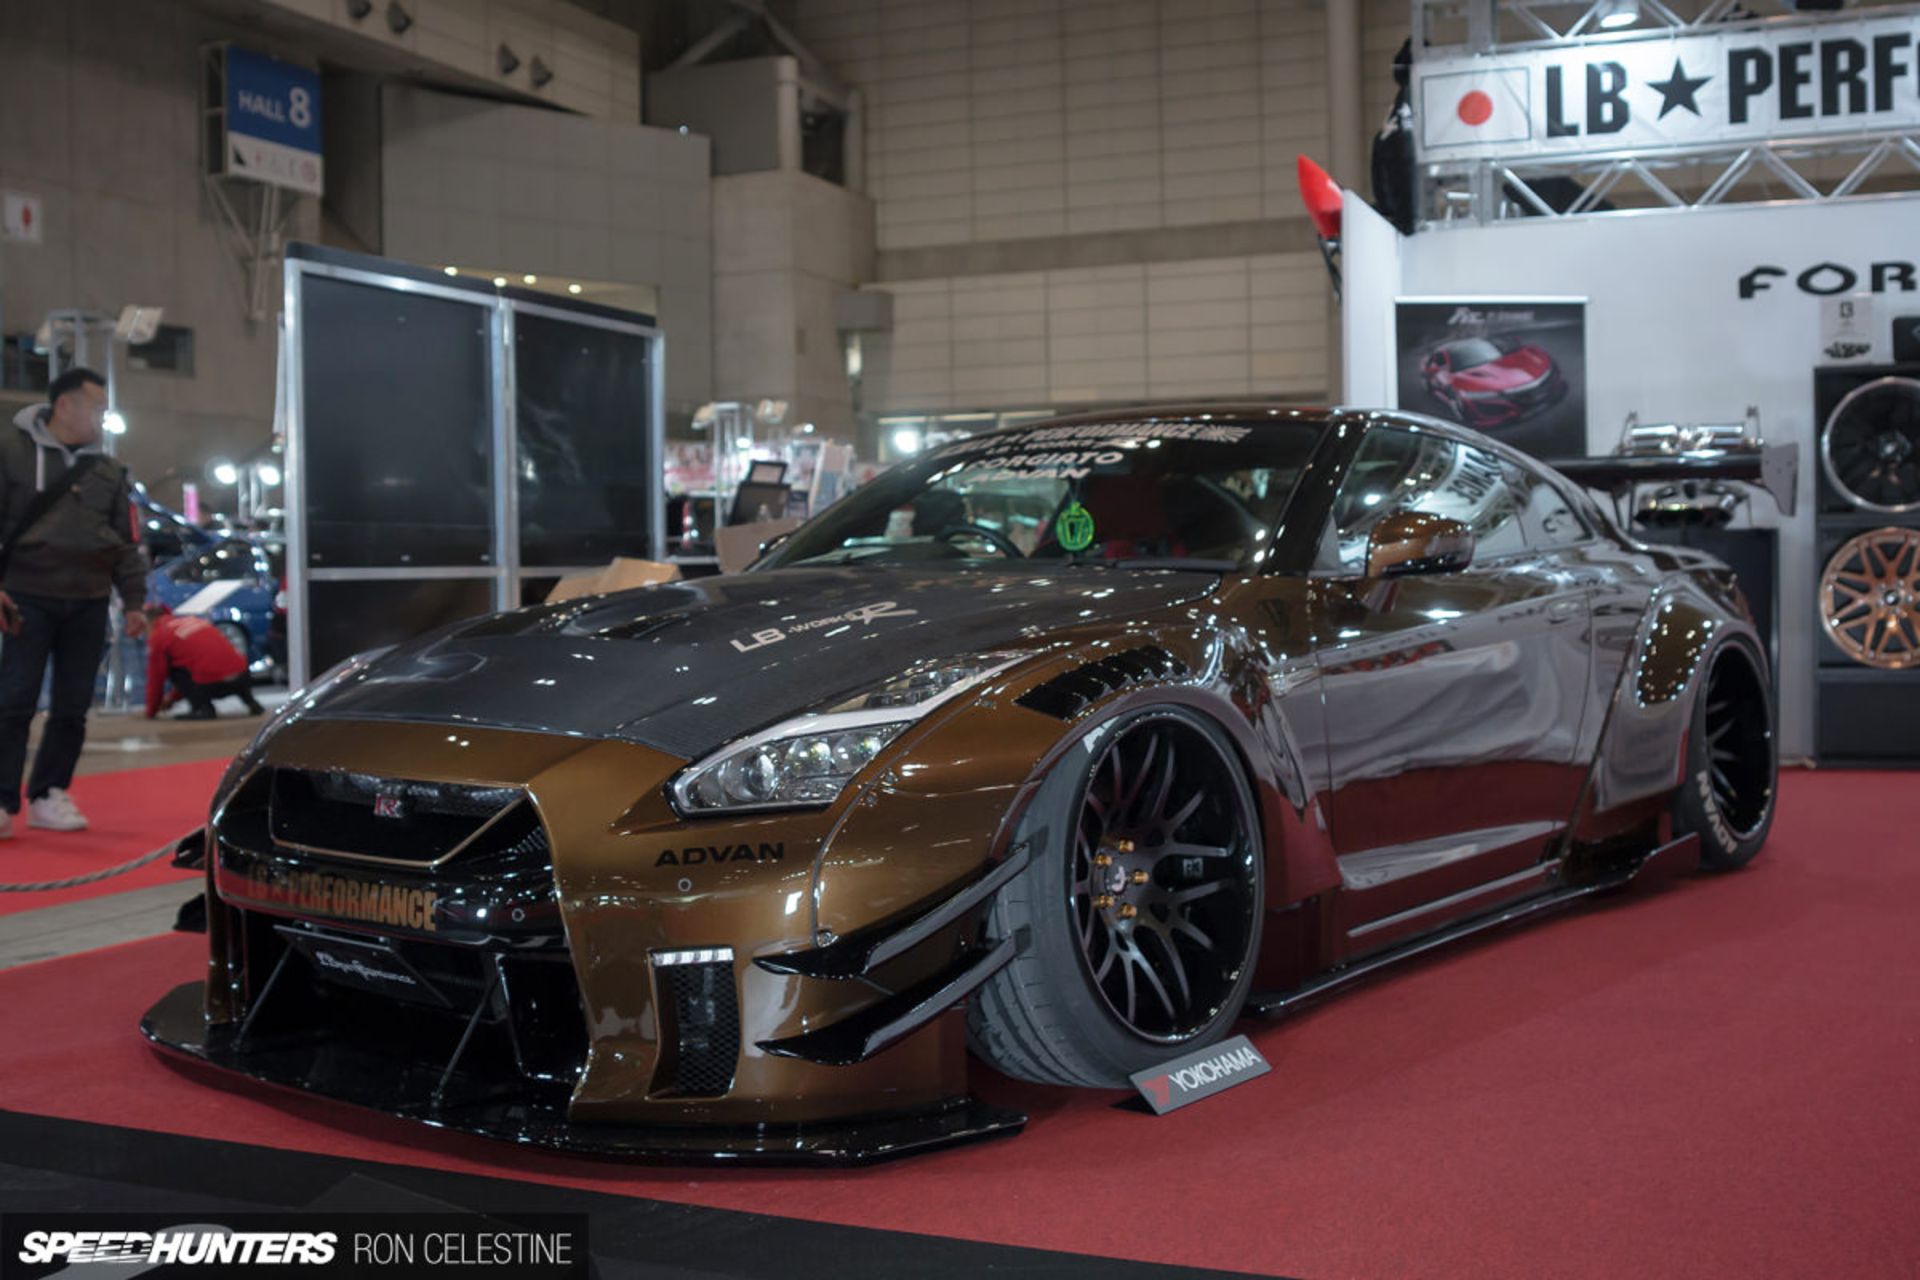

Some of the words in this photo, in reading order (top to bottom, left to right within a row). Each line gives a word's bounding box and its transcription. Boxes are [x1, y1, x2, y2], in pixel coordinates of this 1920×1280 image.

[1545, 61, 1631, 140] LB
[1728, 32, 1920, 124] PERF
[238, 90, 286, 123] HALL
[289, 86, 312, 129] 8
[1738, 261, 1917, 300] FOR
[963, 450, 1125, 472] FORGIATO
[729, 627, 787, 653] LB
[653, 841, 785, 868] ADVAN
[288, 870, 438, 932] PERFORMANCE
[1167, 1046, 1262, 1092] YOKOHAMA
